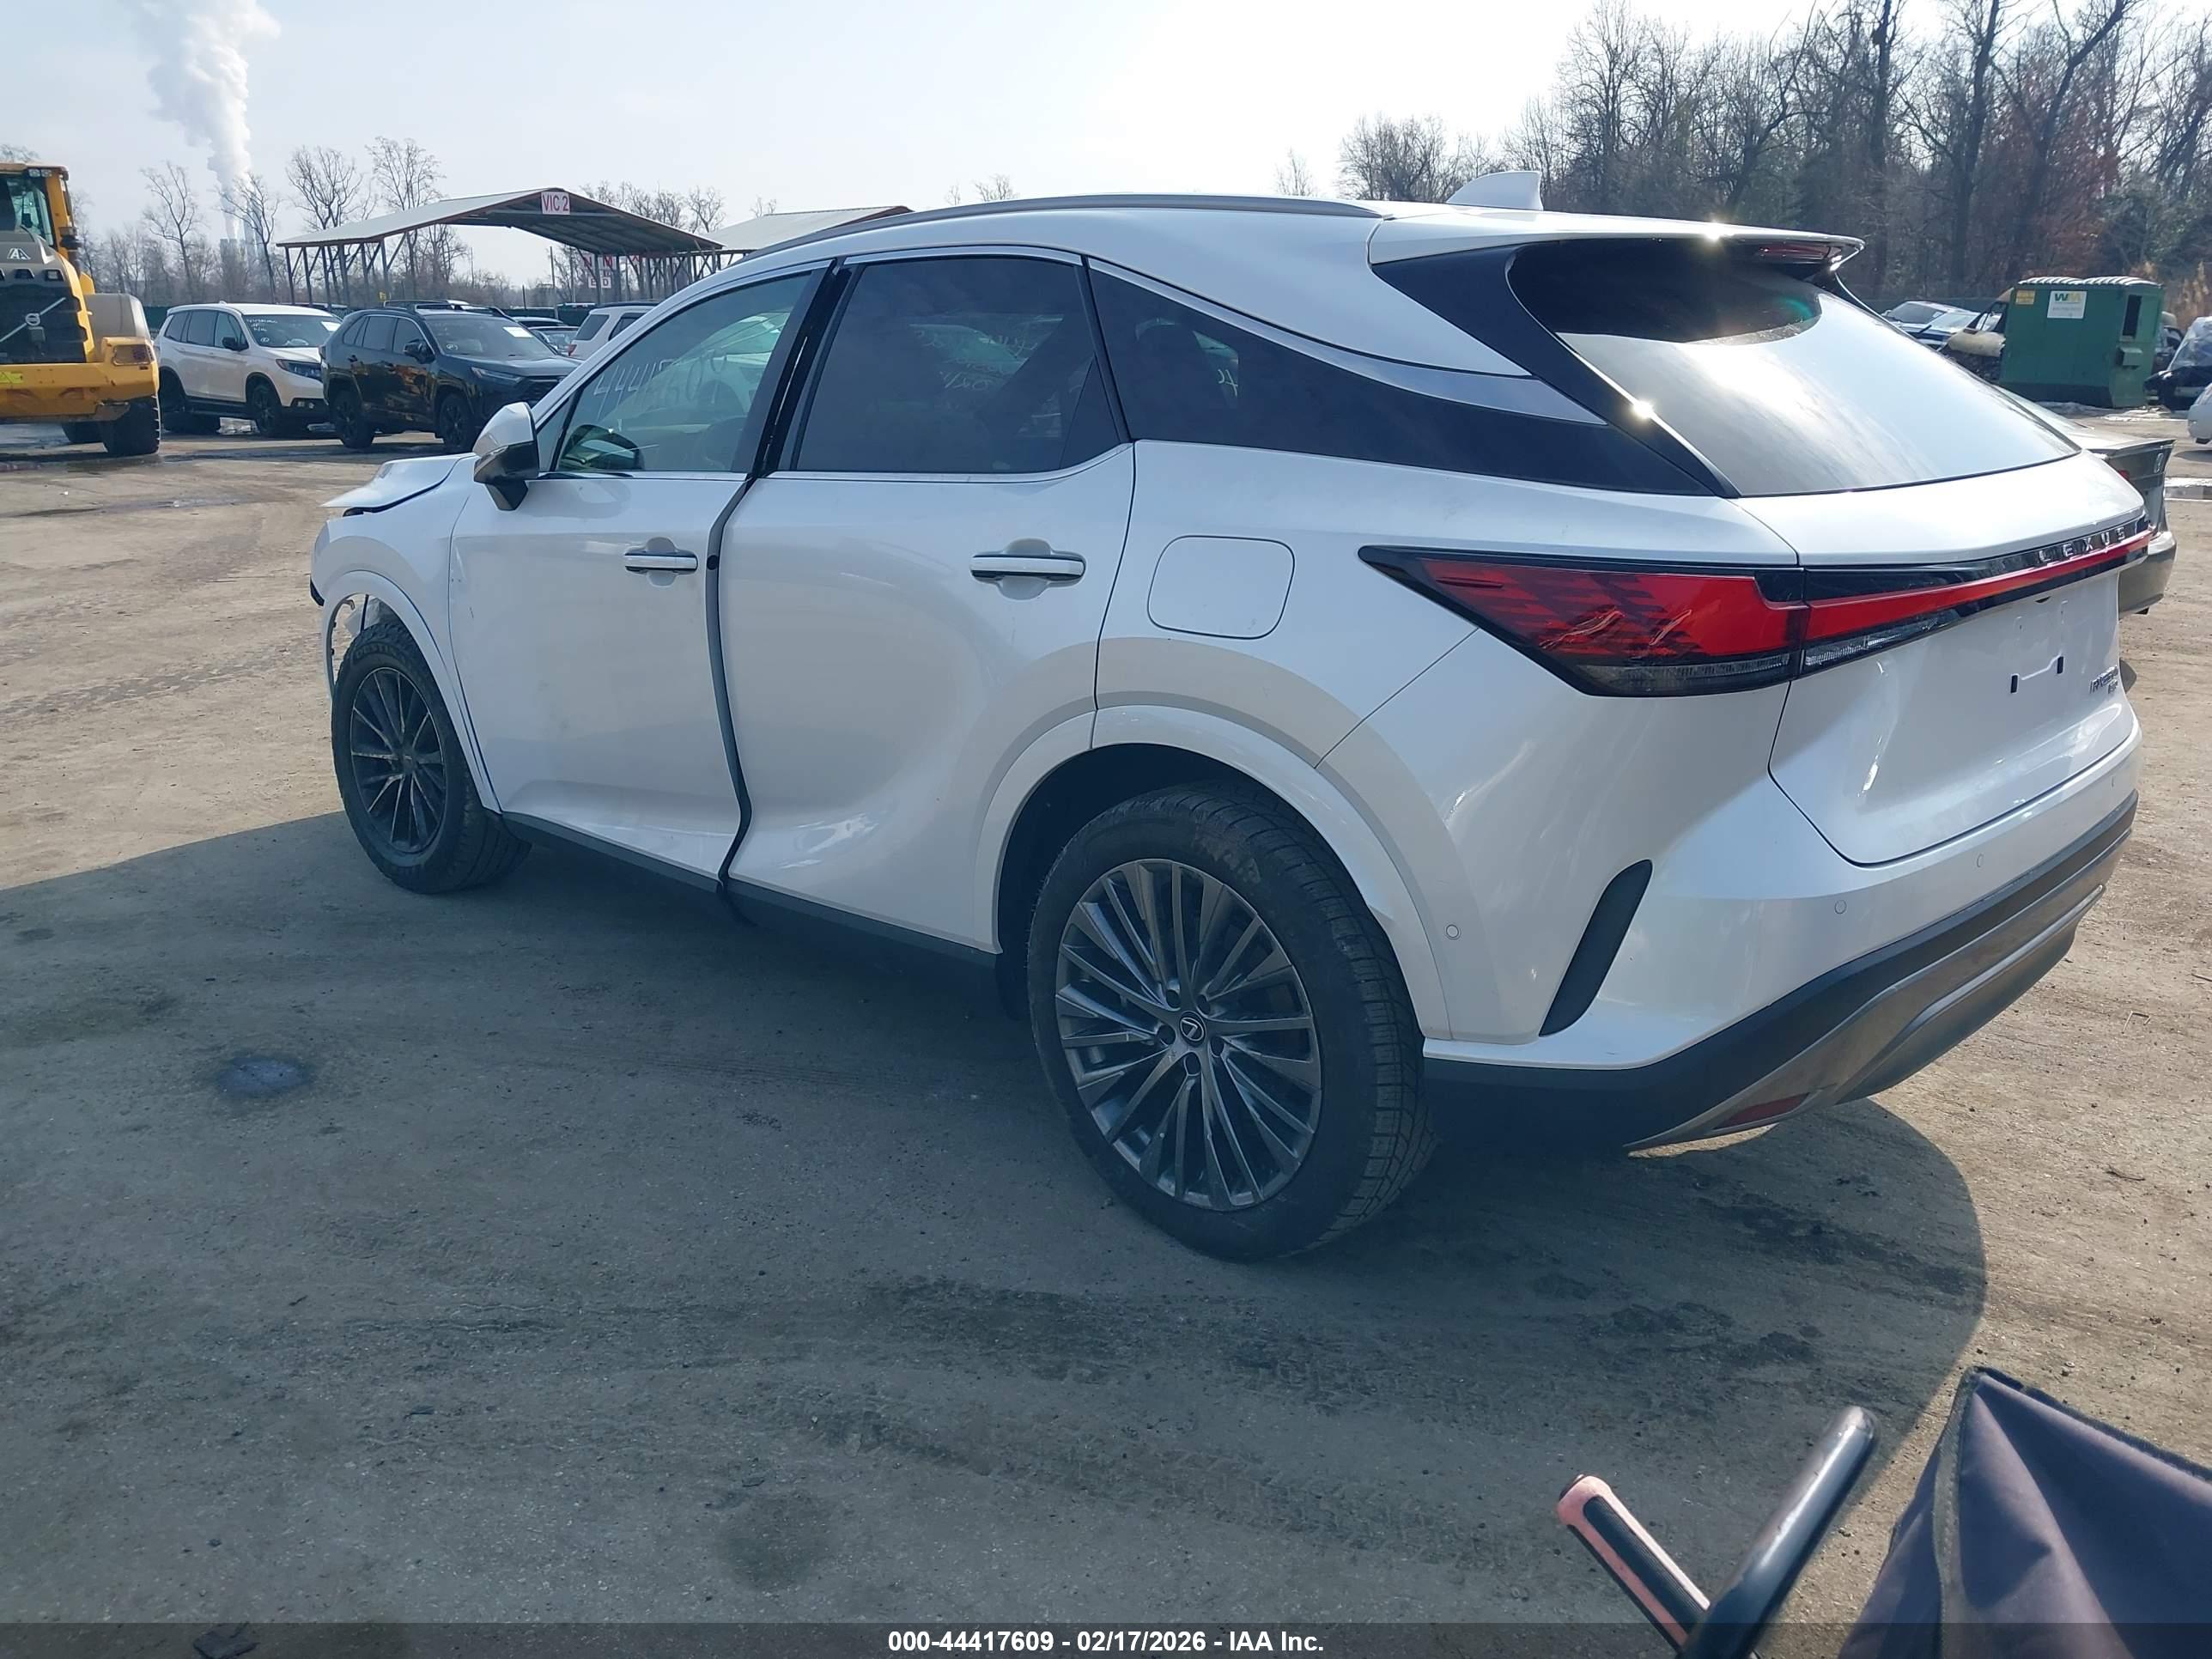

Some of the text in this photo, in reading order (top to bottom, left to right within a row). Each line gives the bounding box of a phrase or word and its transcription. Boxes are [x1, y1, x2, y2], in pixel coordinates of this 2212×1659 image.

[542, 194, 569, 212] VIC 2
[2039, 526, 2126, 562] LEXUS
